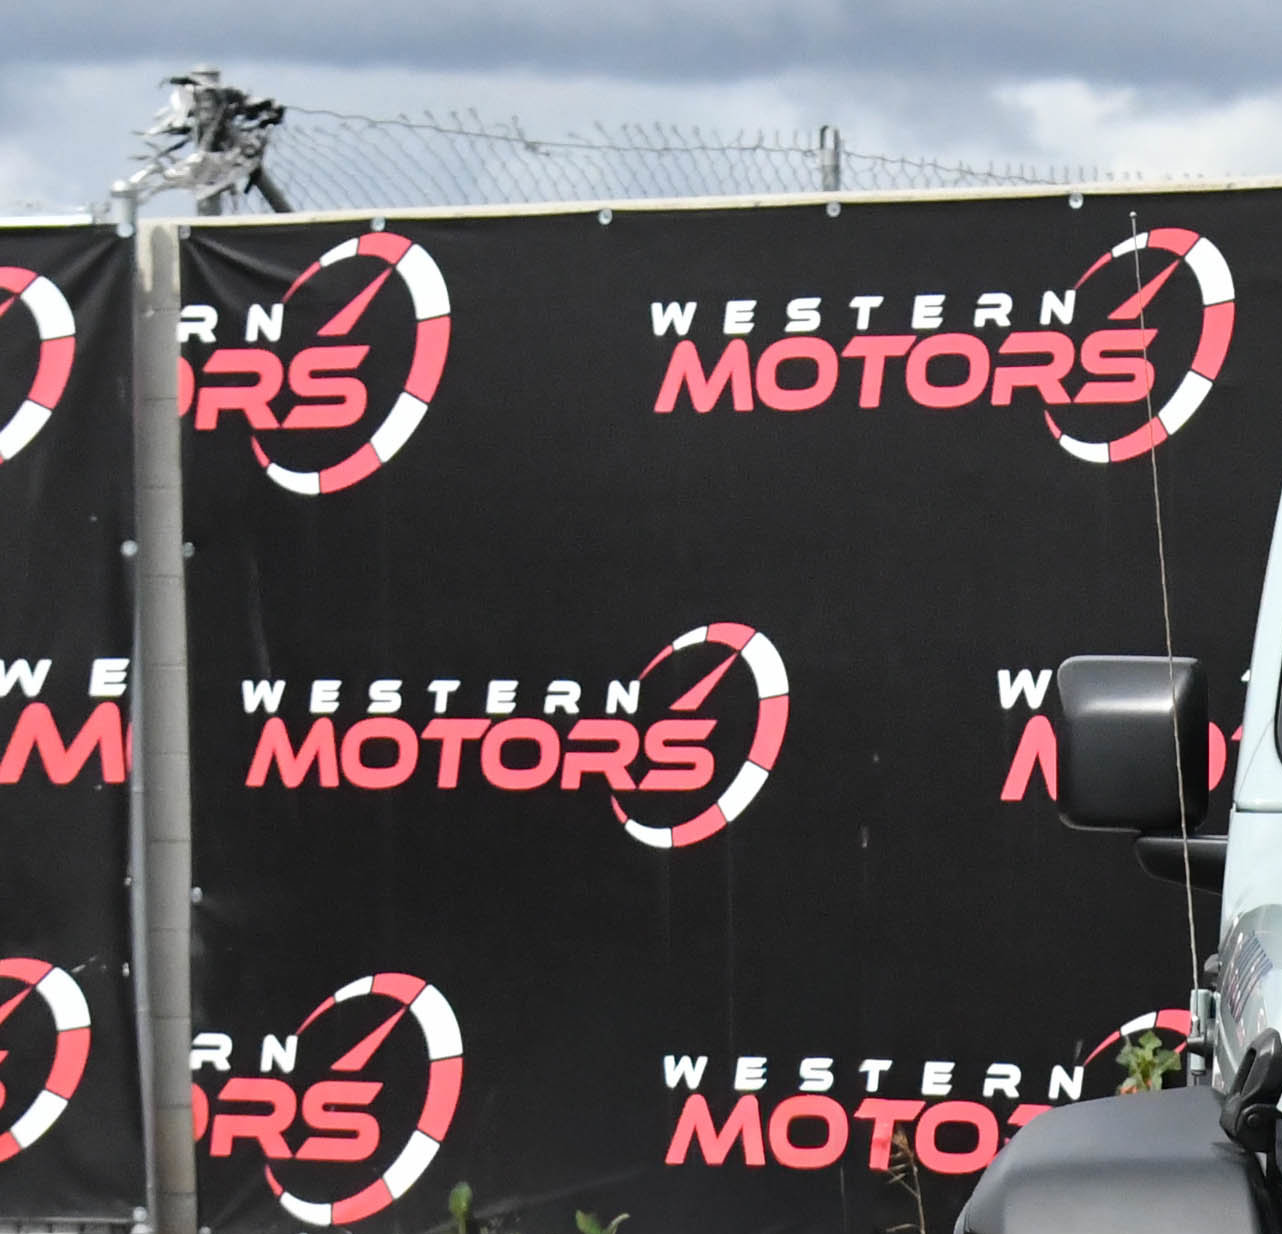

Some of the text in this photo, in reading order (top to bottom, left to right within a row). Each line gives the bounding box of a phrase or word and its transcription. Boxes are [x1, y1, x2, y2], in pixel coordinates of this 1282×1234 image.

[651, 290, 1075, 336] WESTERN
[653, 329, 1158, 413] MOTORS
[242, 680, 640, 714] WESTERN
[246, 717, 718, 790] MOTORS
[664, 1056, 1084, 1099] WESTERN
